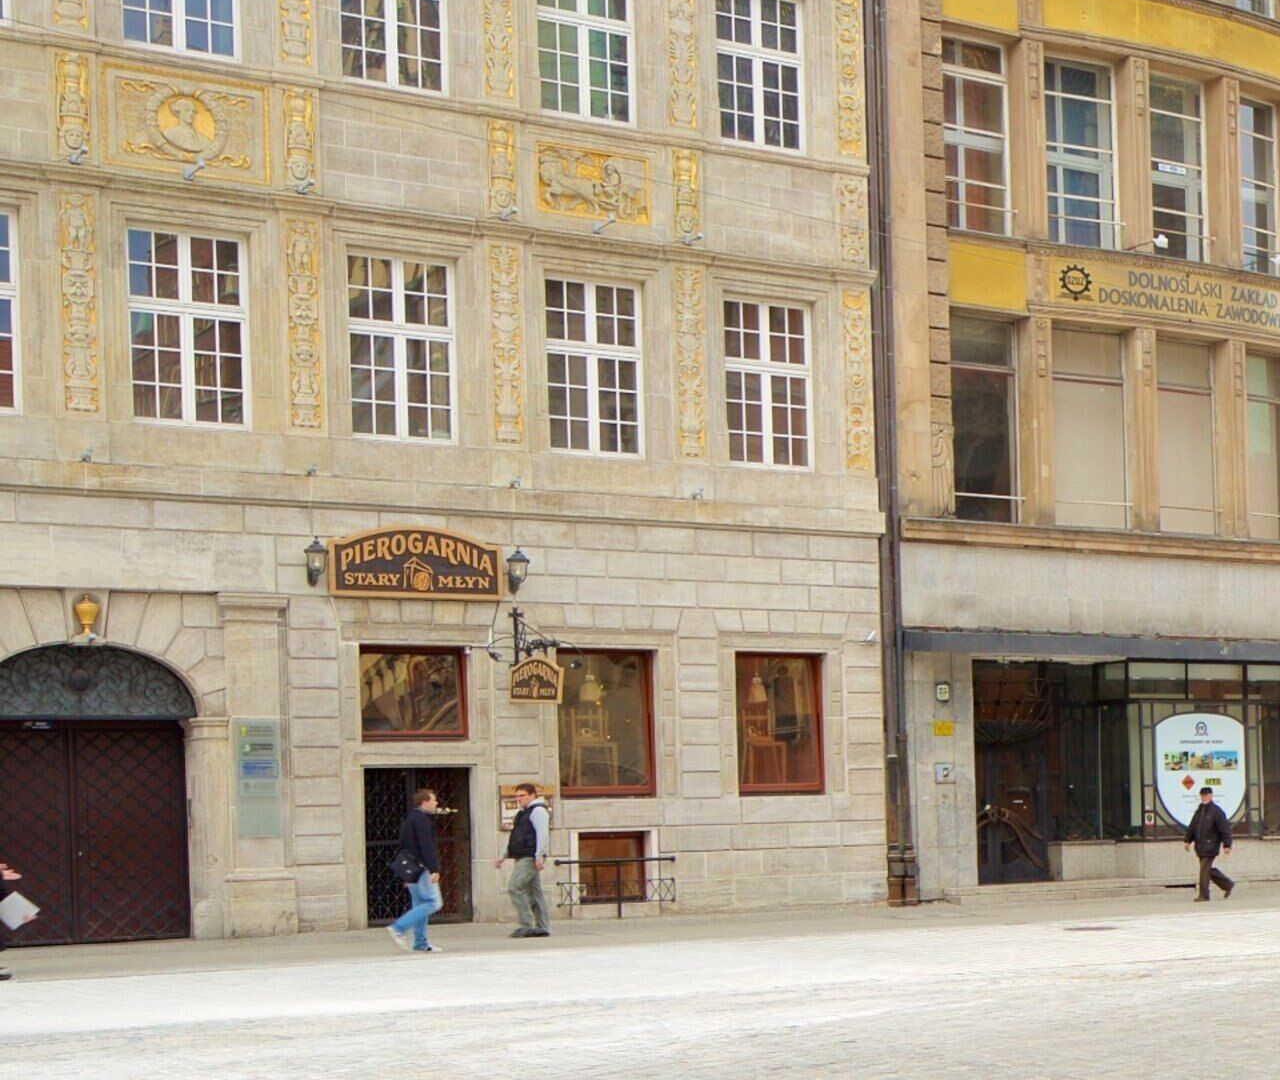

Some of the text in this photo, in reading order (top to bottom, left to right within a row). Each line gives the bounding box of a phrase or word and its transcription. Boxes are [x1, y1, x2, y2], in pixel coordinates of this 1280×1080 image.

[1098, 286, 1209, 317] DOSKONALENIA
[1128, 270, 1278, 309] DOLNOŚLĄSKI ZAKŁAD
[341, 532, 495, 577] PIEROGARNIA
[344, 572, 490, 589] STARY MŁYN
